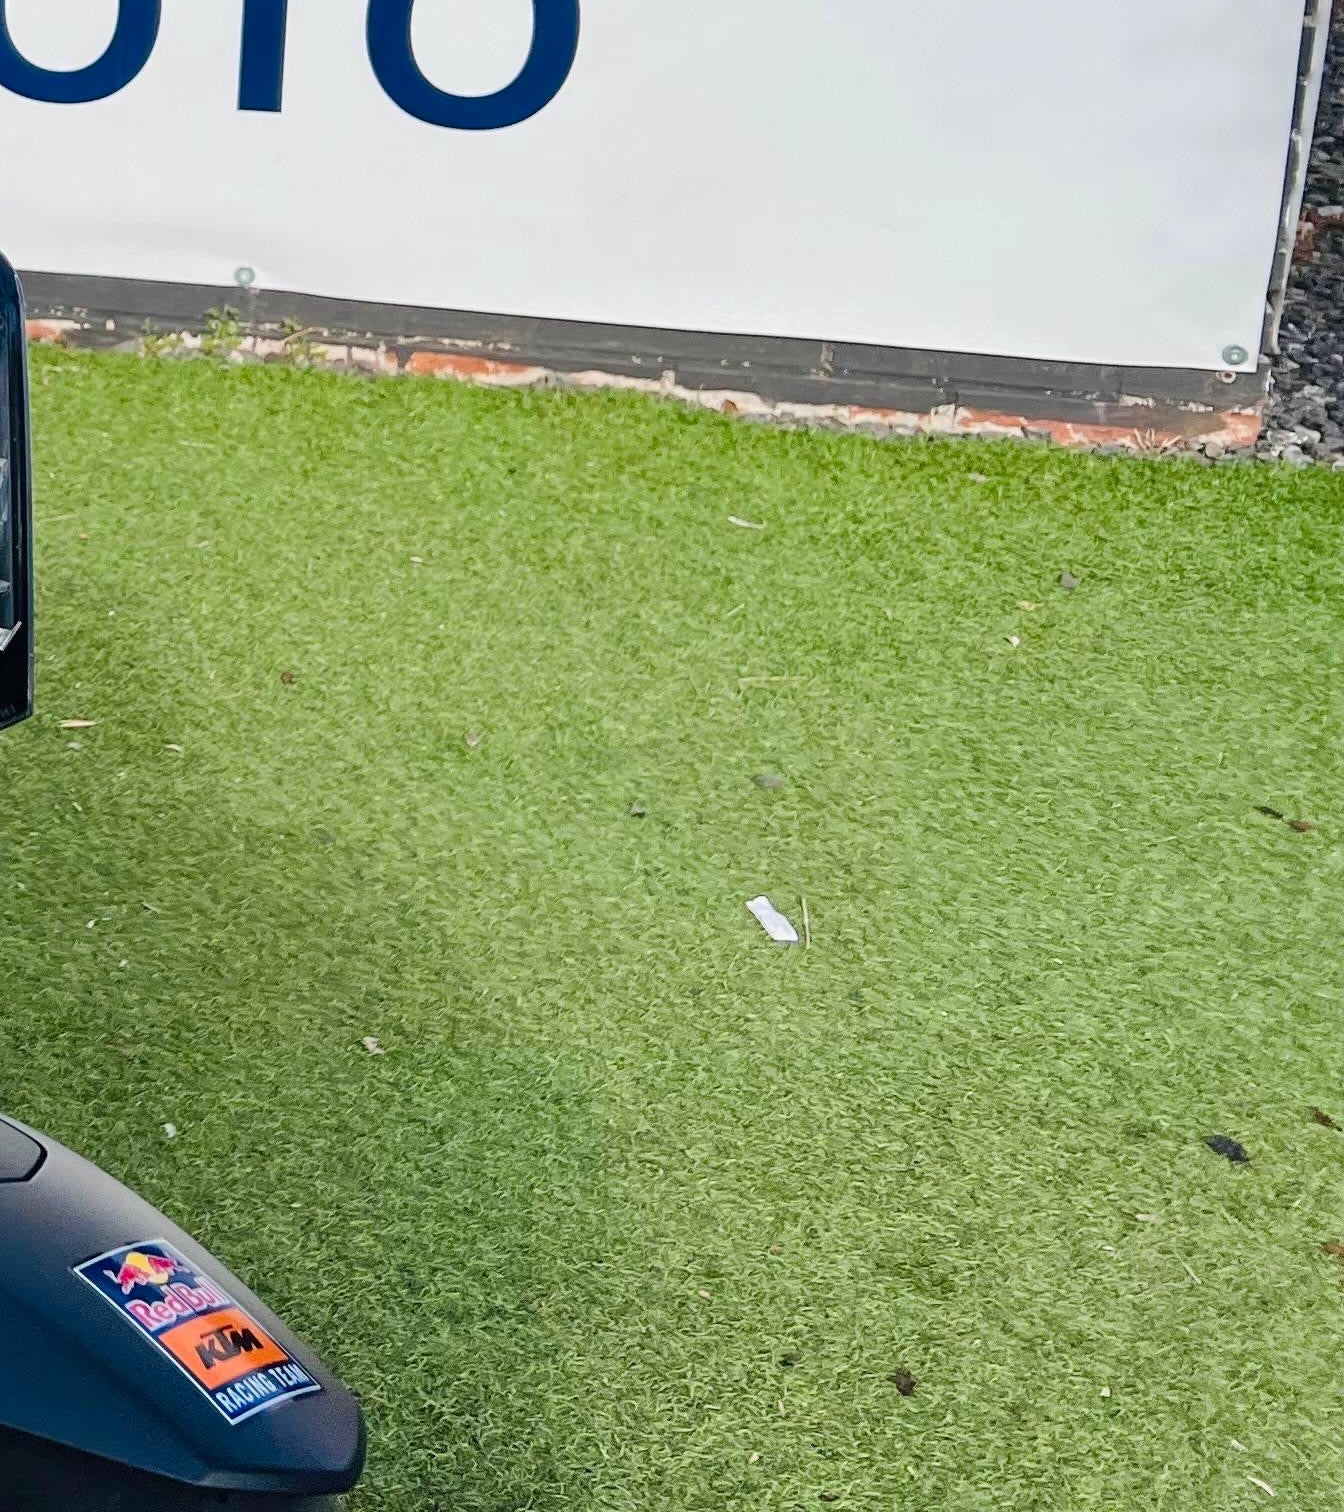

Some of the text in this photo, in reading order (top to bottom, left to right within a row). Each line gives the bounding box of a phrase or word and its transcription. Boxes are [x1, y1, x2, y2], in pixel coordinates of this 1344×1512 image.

[194, 1324, 265, 1370] KTM
[215, 1363, 311, 1414] RACING TEAM
